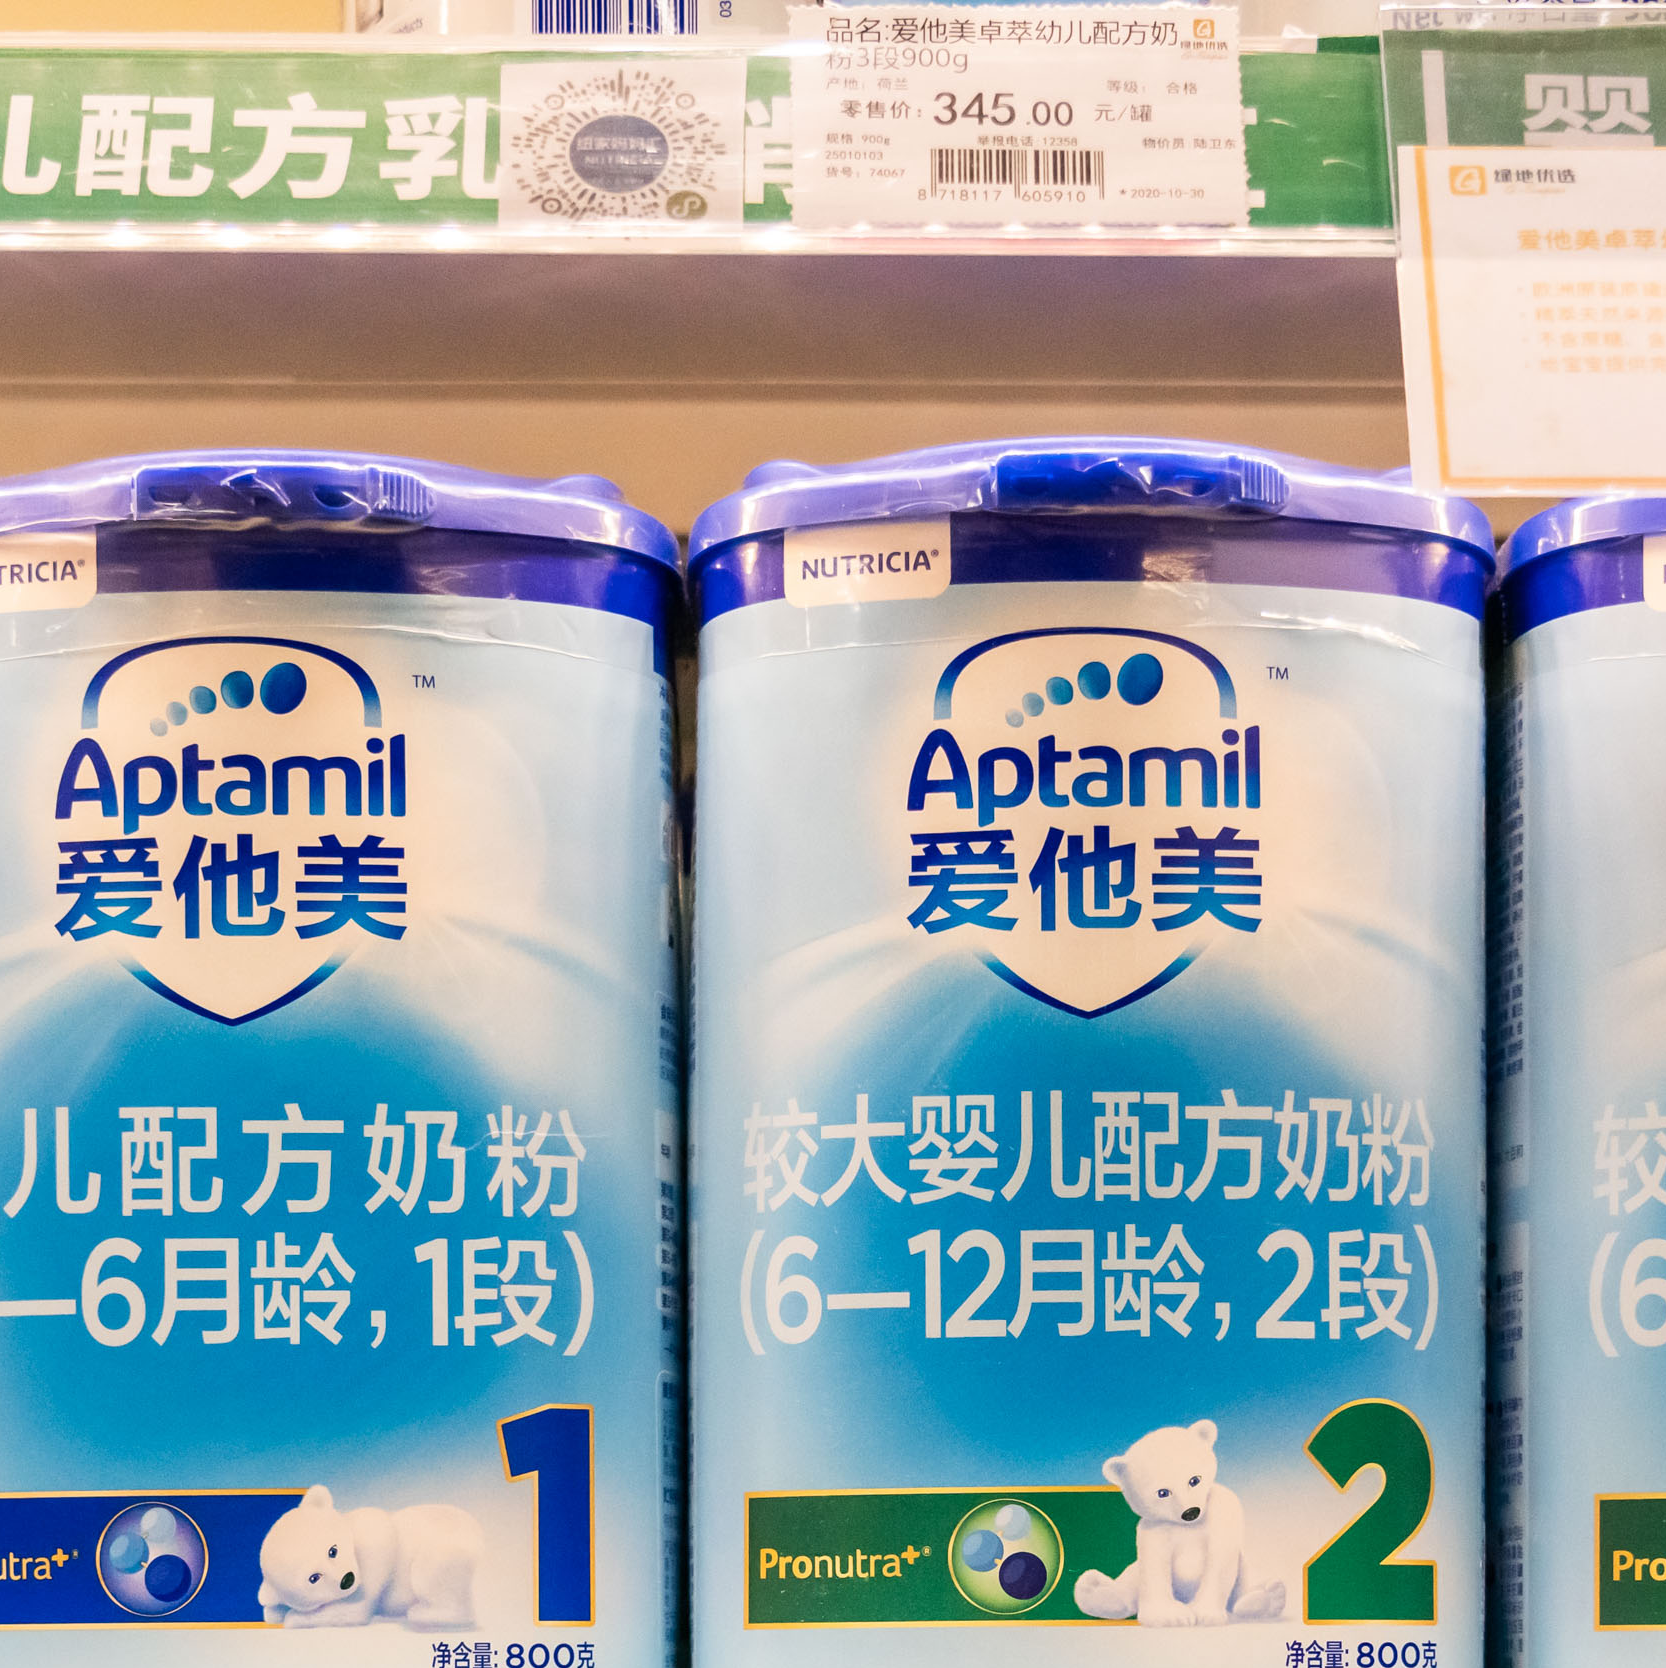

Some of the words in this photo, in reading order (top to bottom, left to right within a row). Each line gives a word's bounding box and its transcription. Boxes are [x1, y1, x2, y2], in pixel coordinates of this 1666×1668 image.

[939, 188, 1003, 203] 718117
[1021, 189, 1087, 204] 605910
[54, 734, 407, 836] Aptamil
[906, 724, 1262, 828] Aptamil
[53, 833, 409, 942] 爱他美
[907, 825, 1263, 936] 爱他美
[743, 1088, 1435, 1216] 较大婴儿配方奶粉
[495, 1402, 596, 1628] 1
[1301, 1397, 1438, 1627] 2
